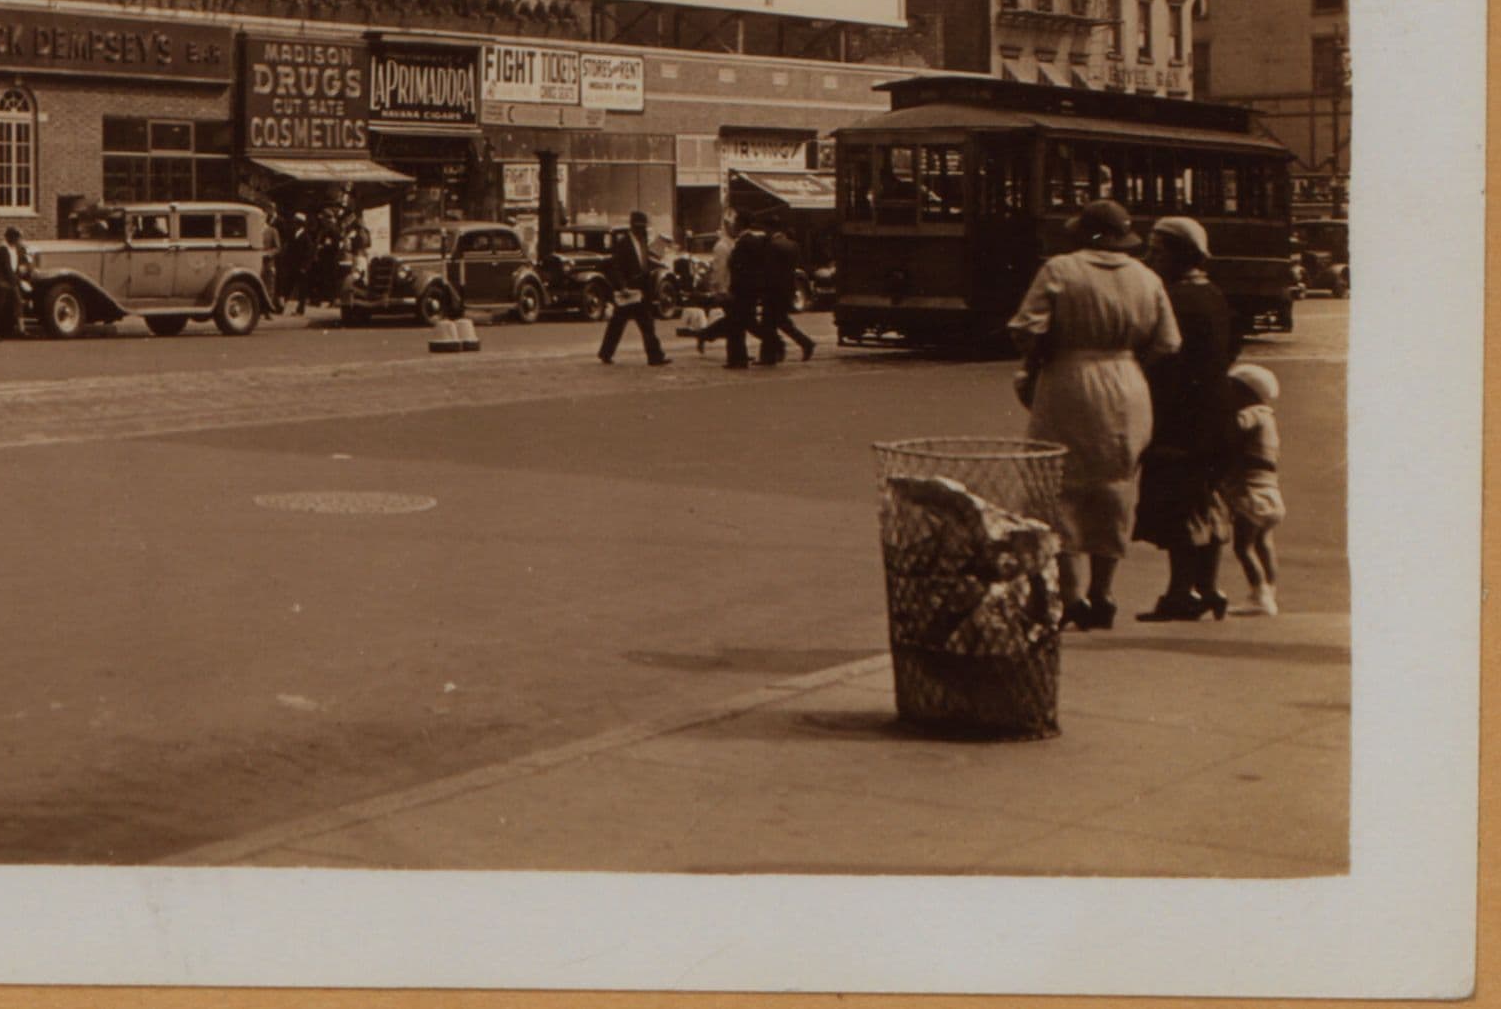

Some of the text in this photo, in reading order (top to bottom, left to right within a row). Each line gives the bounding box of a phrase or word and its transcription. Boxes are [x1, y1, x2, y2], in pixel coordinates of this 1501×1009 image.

[33, 25, 175, 67] DEMPSEY'S
[263, 43, 353, 67] MADISON
[252, 63, 363, 98] DRUGS
[485, 47, 578, 85] FIGHT TICKETS
[272, 98, 346, 117] CUT RATE
[250, 117, 367, 148] COSMETICS
